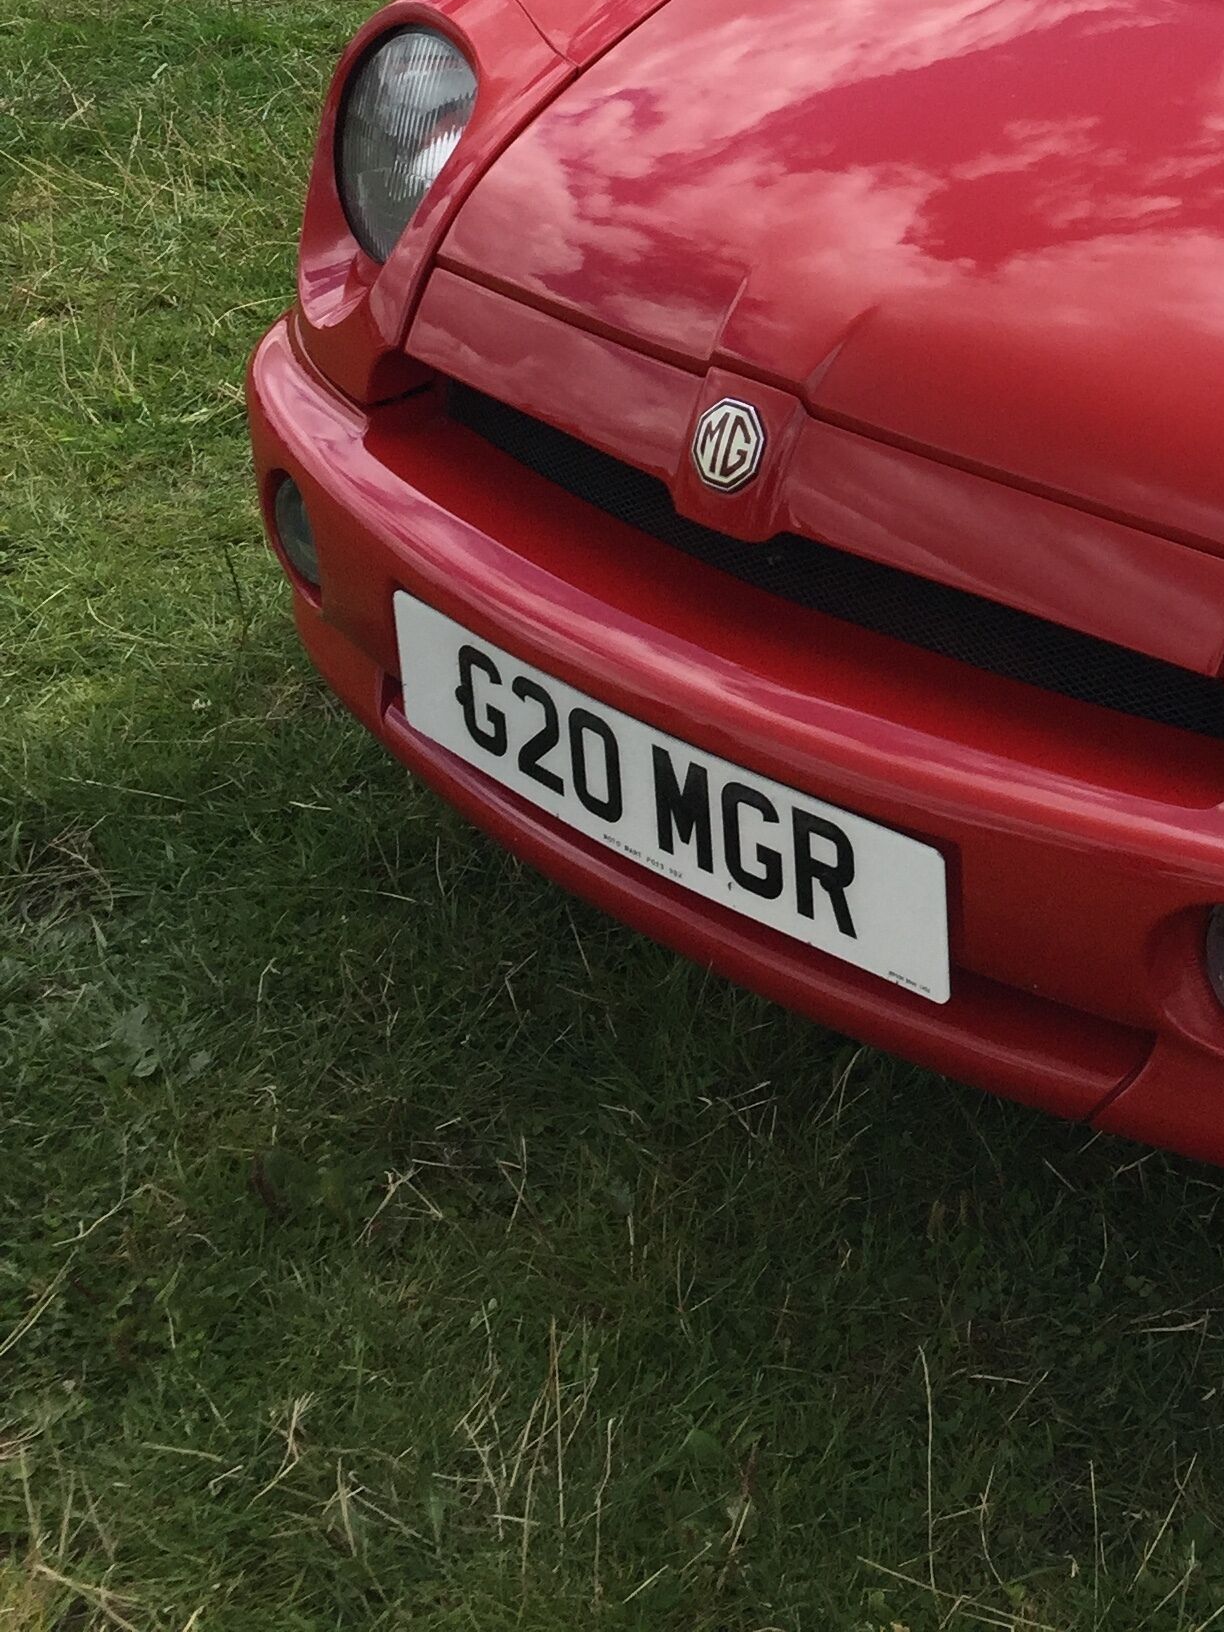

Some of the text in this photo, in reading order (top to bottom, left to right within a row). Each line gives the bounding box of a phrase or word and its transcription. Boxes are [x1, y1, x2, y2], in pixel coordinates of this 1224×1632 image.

[700, 411, 752, 478] MG
[456, 644, 857, 940] G20 MGR
